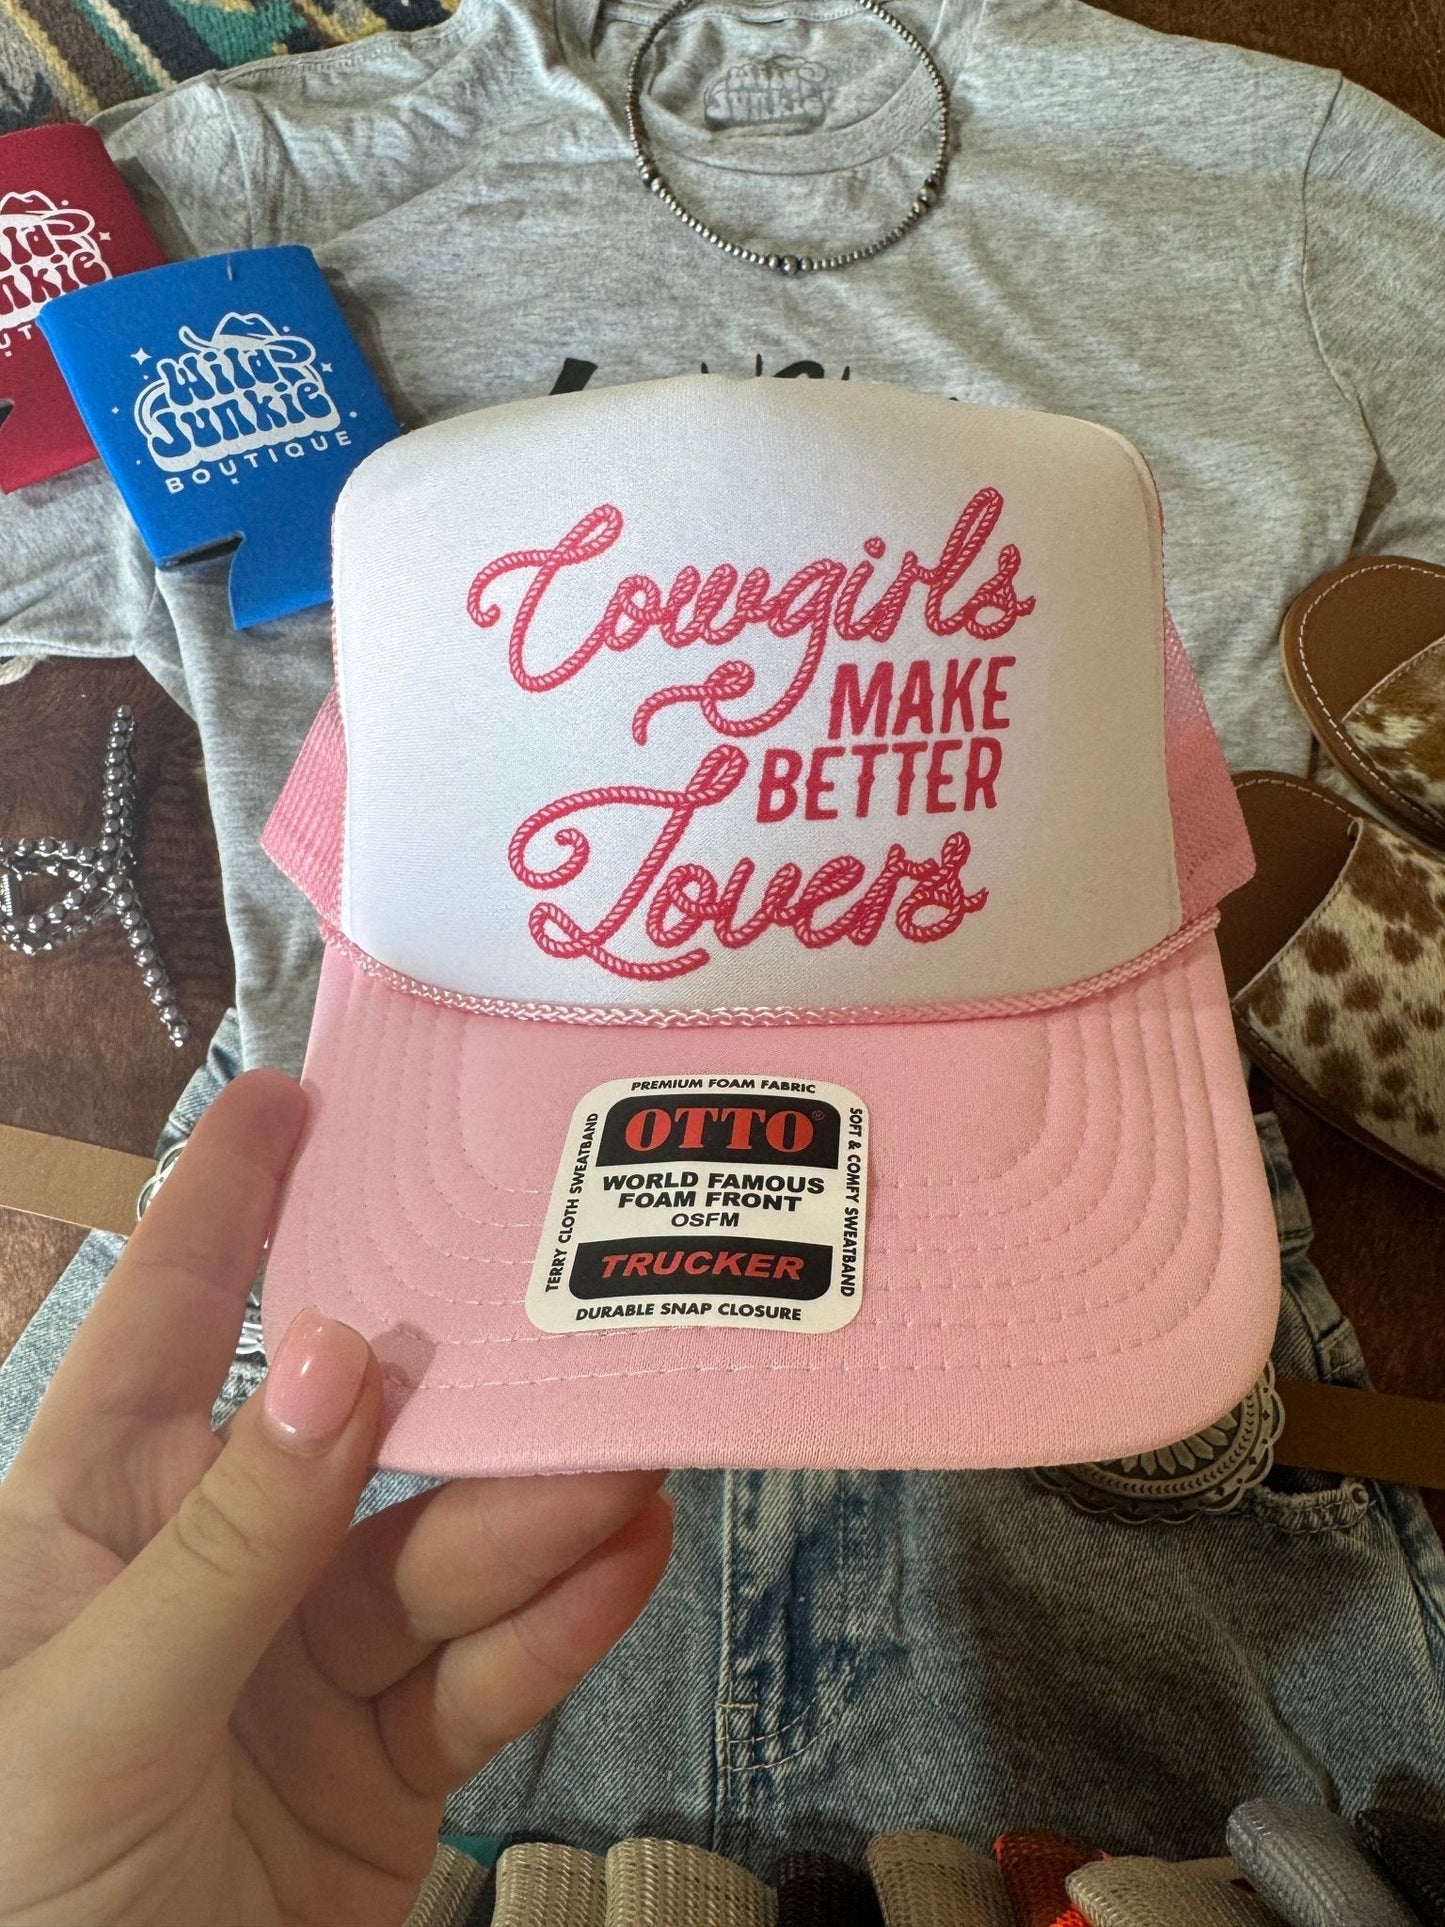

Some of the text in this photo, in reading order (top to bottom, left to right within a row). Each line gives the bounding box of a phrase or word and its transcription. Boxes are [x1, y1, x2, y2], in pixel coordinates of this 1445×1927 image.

[160, 347, 280, 406] Wild
[151, 382, 333, 458] Junkie
[165, 431, 352, 494] BOUTIQUE
[466, 487, 1036, 745] Cowgirls
[828, 656, 1017, 740] MAKE
[756, 737, 1003, 824] BETTER
[508, 744, 989, 982] Lovers
[631, 1078, 817, 1094] PREMIUM FOAM FABRIC
[545, 1112, 599, 1293] TERRY CLOTH SWEATBAND
[603, 1171, 825, 1195] WORLD FAMOUS
[618, 1191, 803, 1212] FOAM FRONT
[840, 1107, 863, 1298] SOFT & COMFY SWEATBAND
[671, 1212, 740, 1228] OSFM
[601, 1251, 805, 1281] TRUCKER
[575, 1302, 802, 1321] DURABLE SNAP CLOSURE
